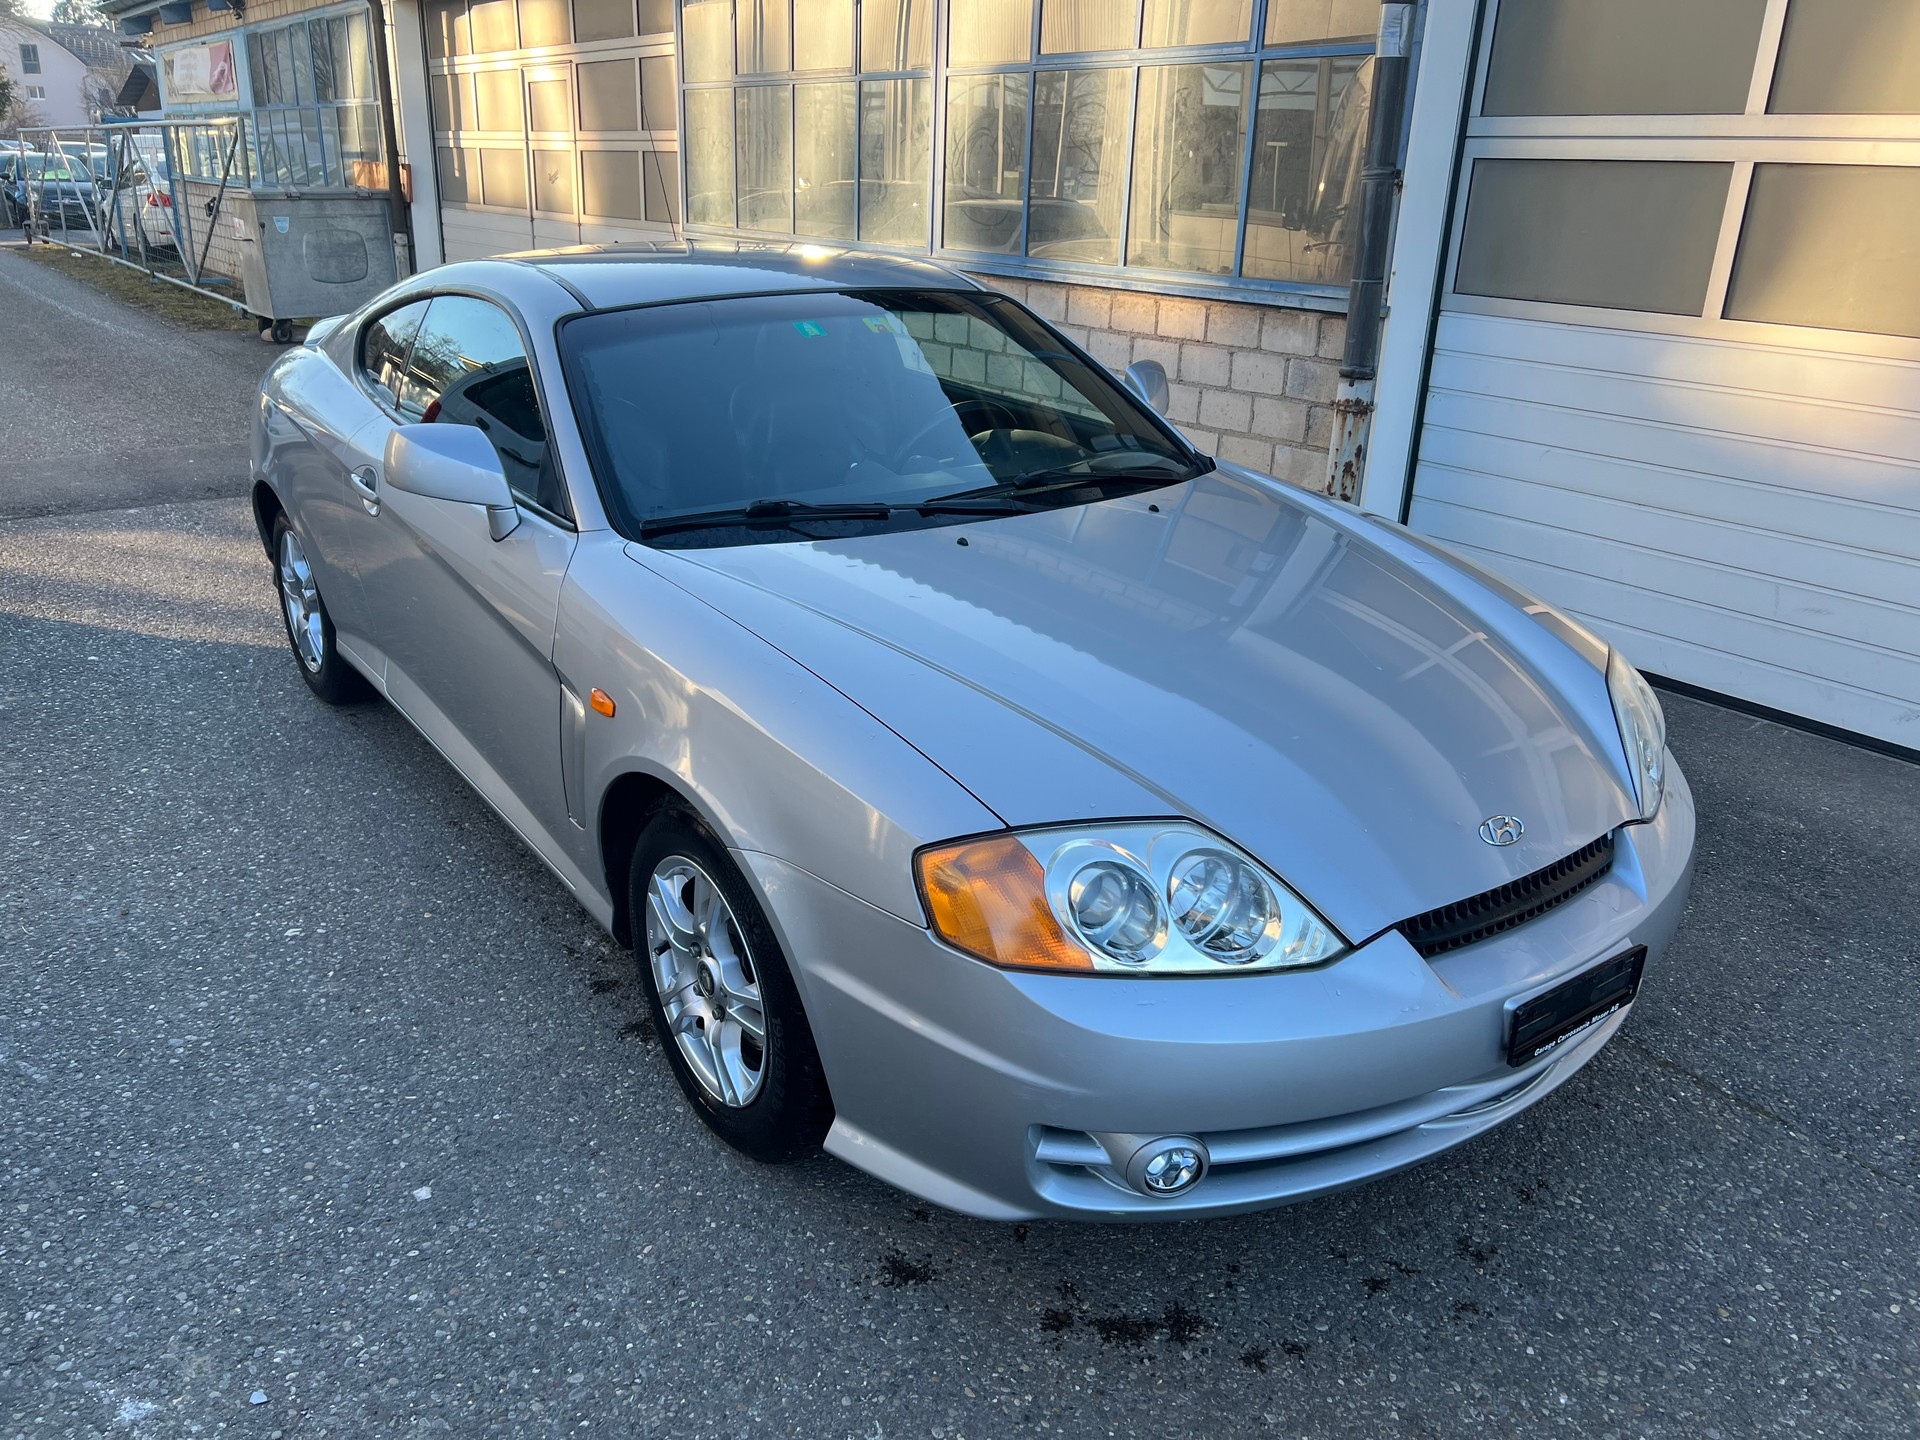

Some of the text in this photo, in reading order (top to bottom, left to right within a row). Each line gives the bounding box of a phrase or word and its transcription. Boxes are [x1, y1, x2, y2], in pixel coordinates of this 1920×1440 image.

[1534, 1003, 1620, 1056] Garage Carrosserie Moser AG
